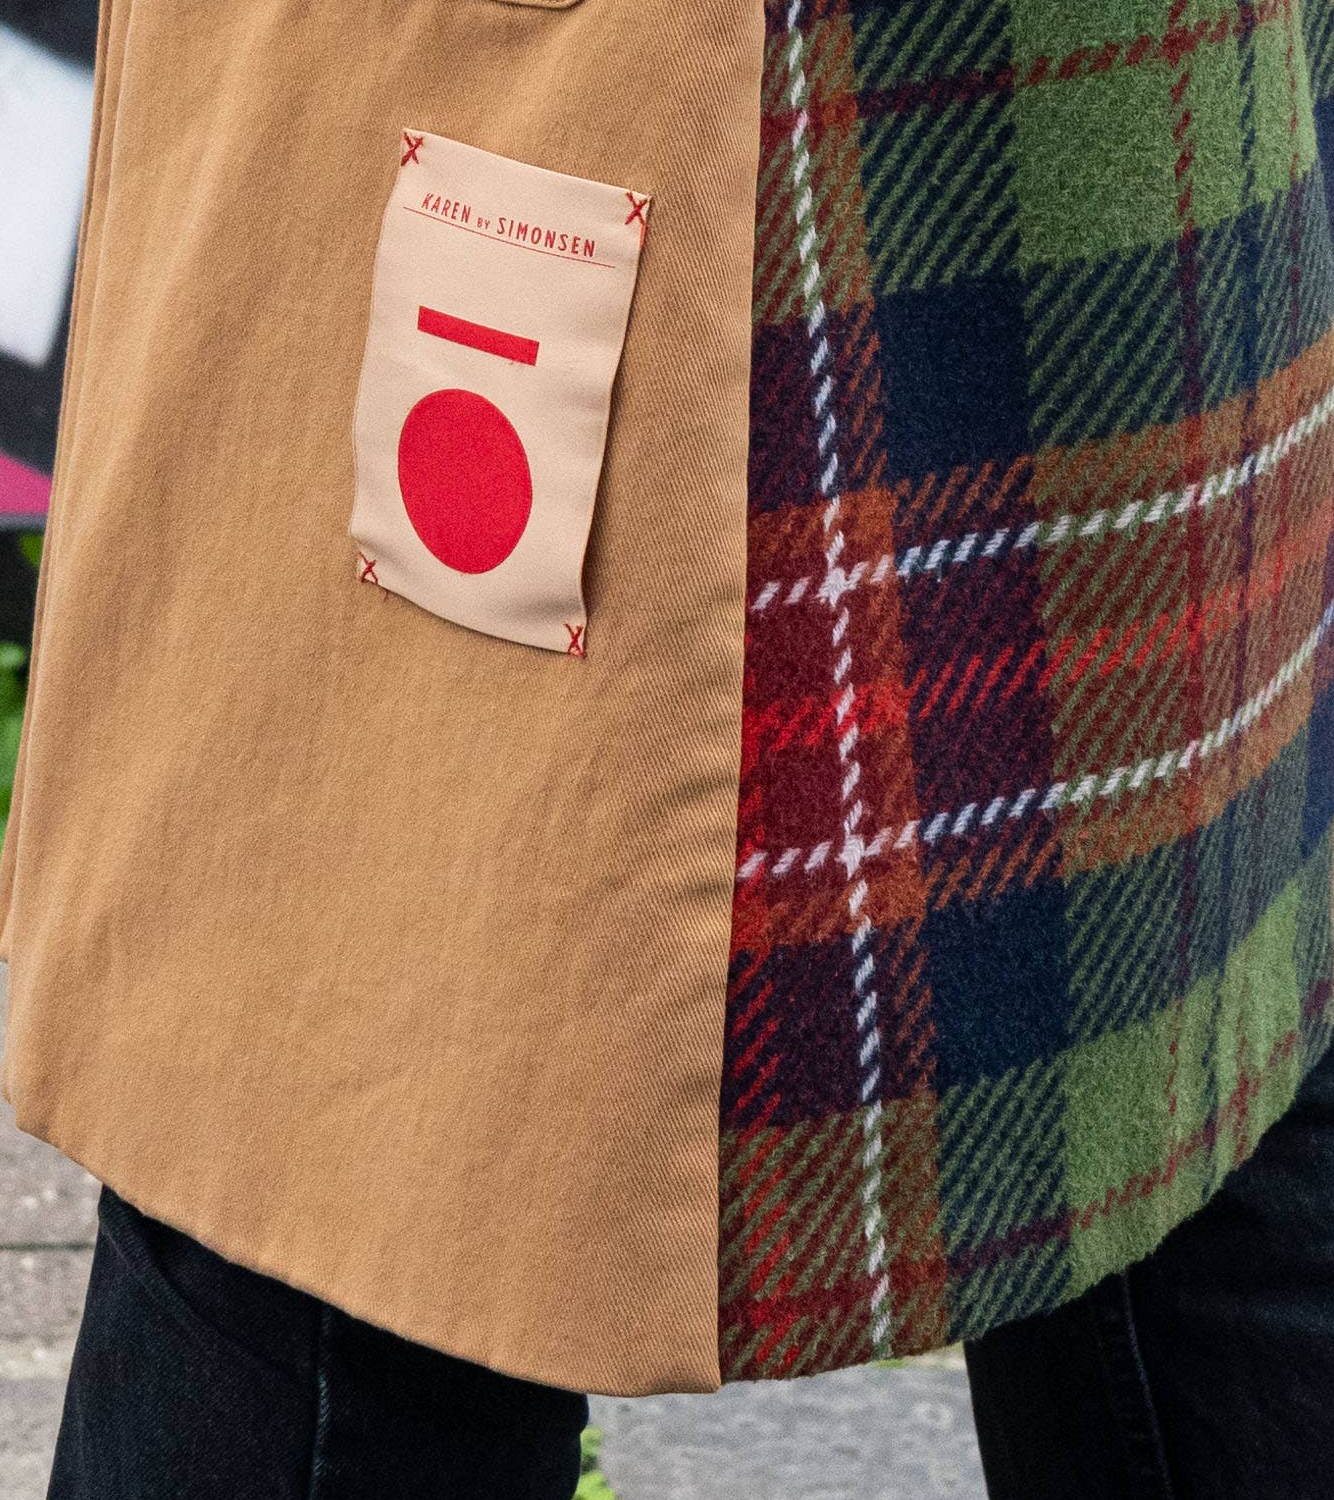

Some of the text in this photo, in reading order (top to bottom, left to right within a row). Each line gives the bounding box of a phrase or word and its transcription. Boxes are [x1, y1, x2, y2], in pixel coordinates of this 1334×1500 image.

[421, 193, 595, 257] KAREN BY SIMONSEN
